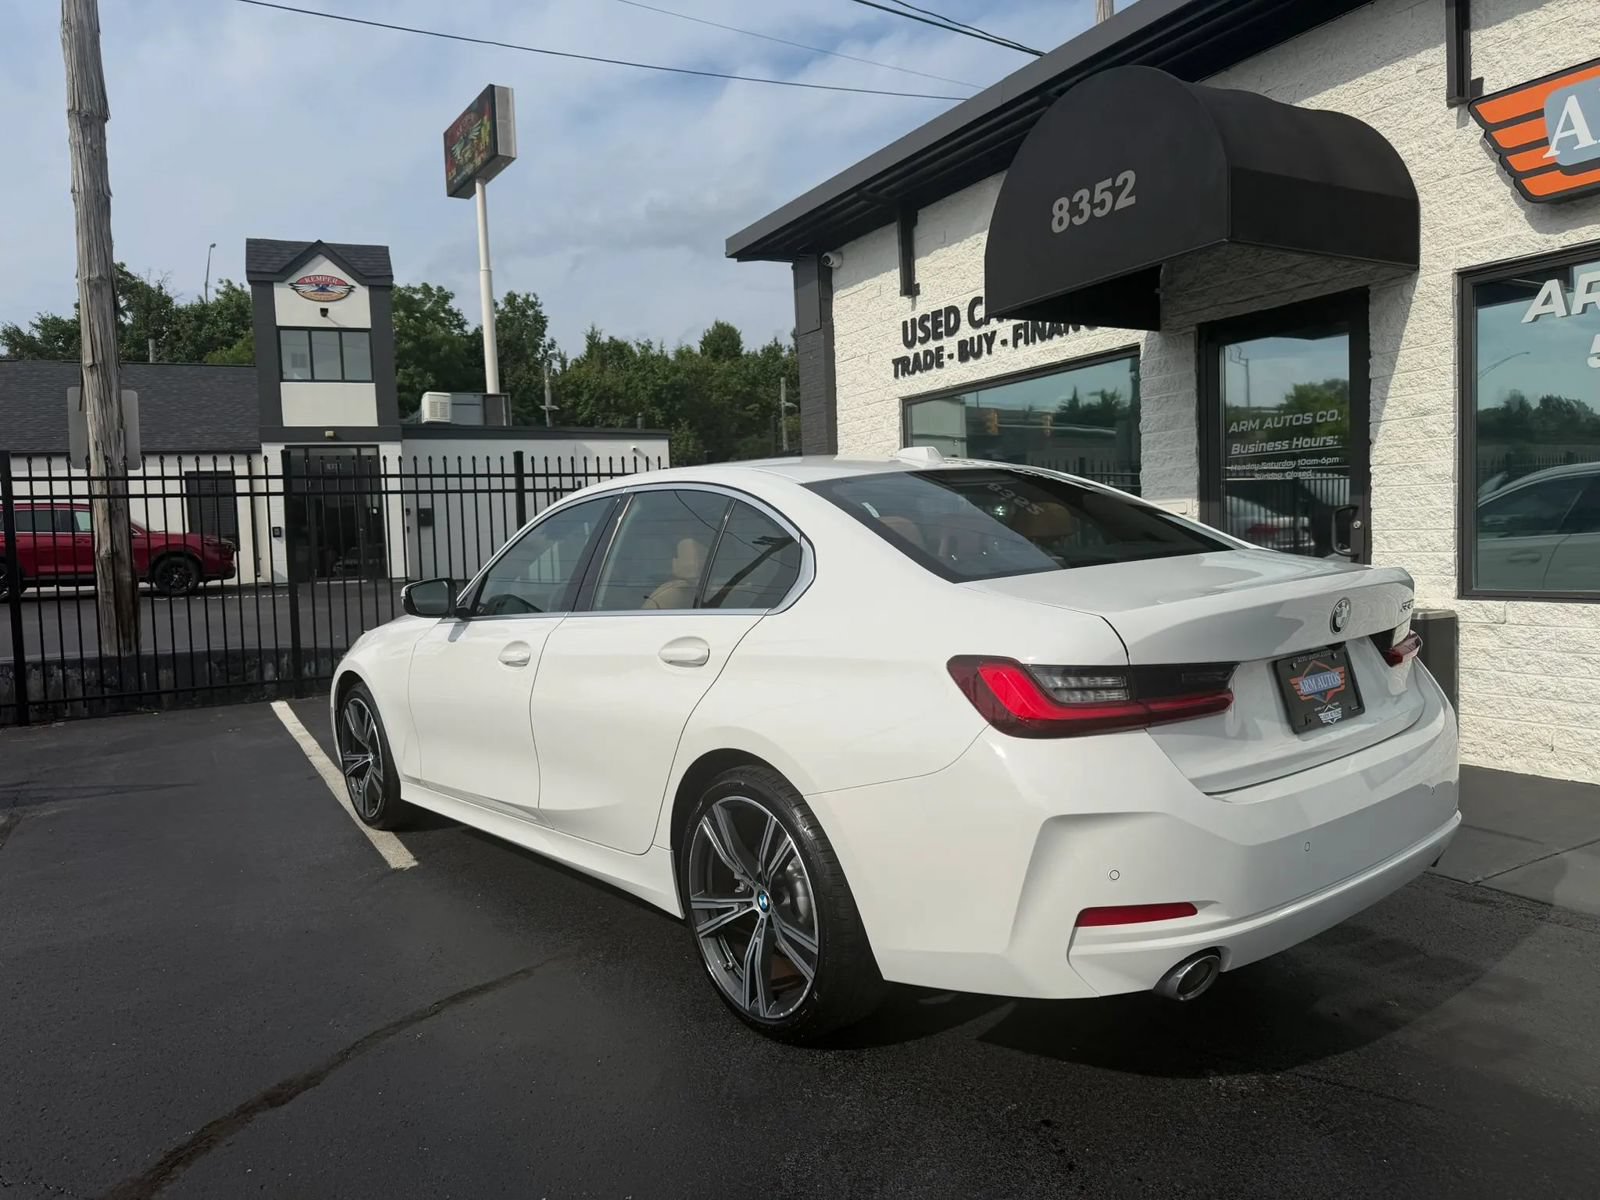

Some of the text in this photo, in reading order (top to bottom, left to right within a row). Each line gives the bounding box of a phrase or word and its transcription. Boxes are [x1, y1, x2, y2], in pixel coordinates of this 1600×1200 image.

[1542, 94, 1600, 159] A
[1051, 169, 1136, 233] 8352
[304, 275, 338, 284] KEMPER
[901, 305, 961, 349] USED
[892, 346, 944, 379] TRADE
[957, 330, 997, 362] BUY
[1228, 409, 1342, 433] ARM AUTOS CO.
[1231, 435, 1339, 455] Business Hours:
[1301, 671, 1341, 693] ARM AUTOS
